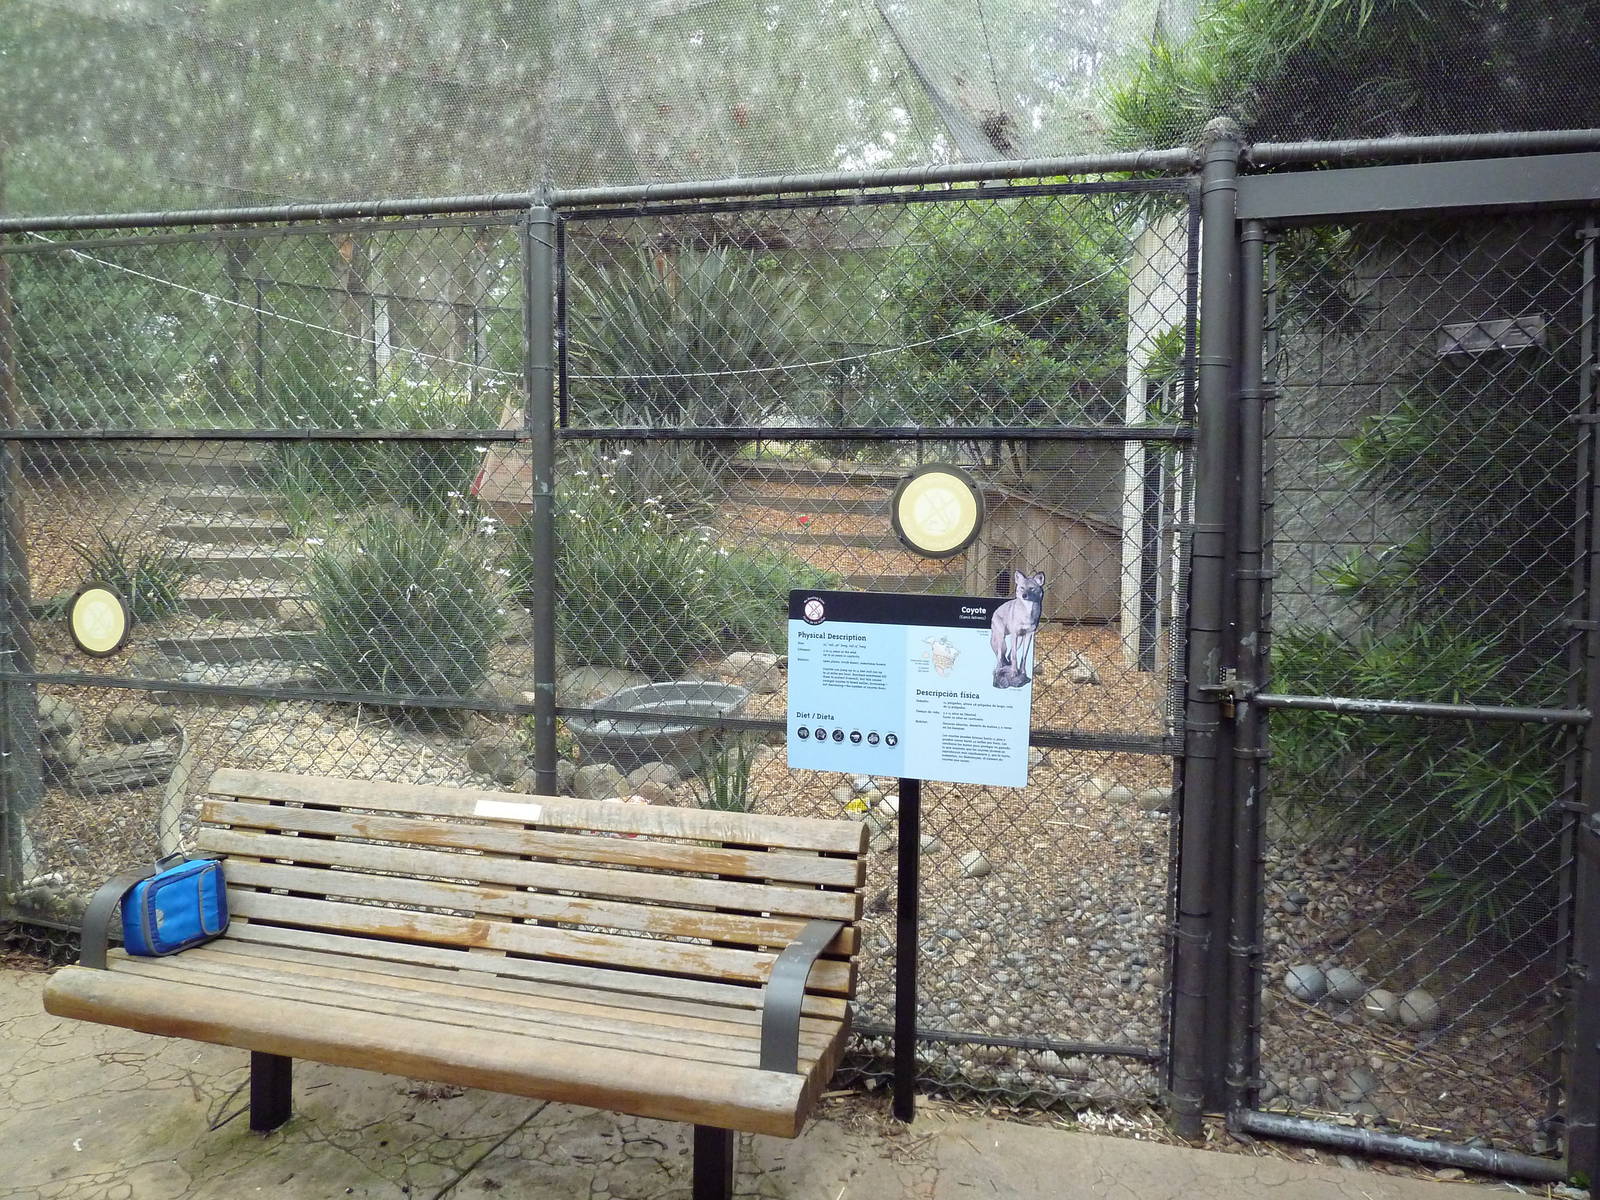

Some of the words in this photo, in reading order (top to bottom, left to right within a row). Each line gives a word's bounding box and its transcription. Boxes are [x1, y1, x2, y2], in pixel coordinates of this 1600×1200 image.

[961, 606, 987, 615] Coyote
[798, 632, 826, 640] Physical
[827, 633, 867, 642] Description
[916, 689, 958, 698] Descripción
[960, 691, 980, 699] física
